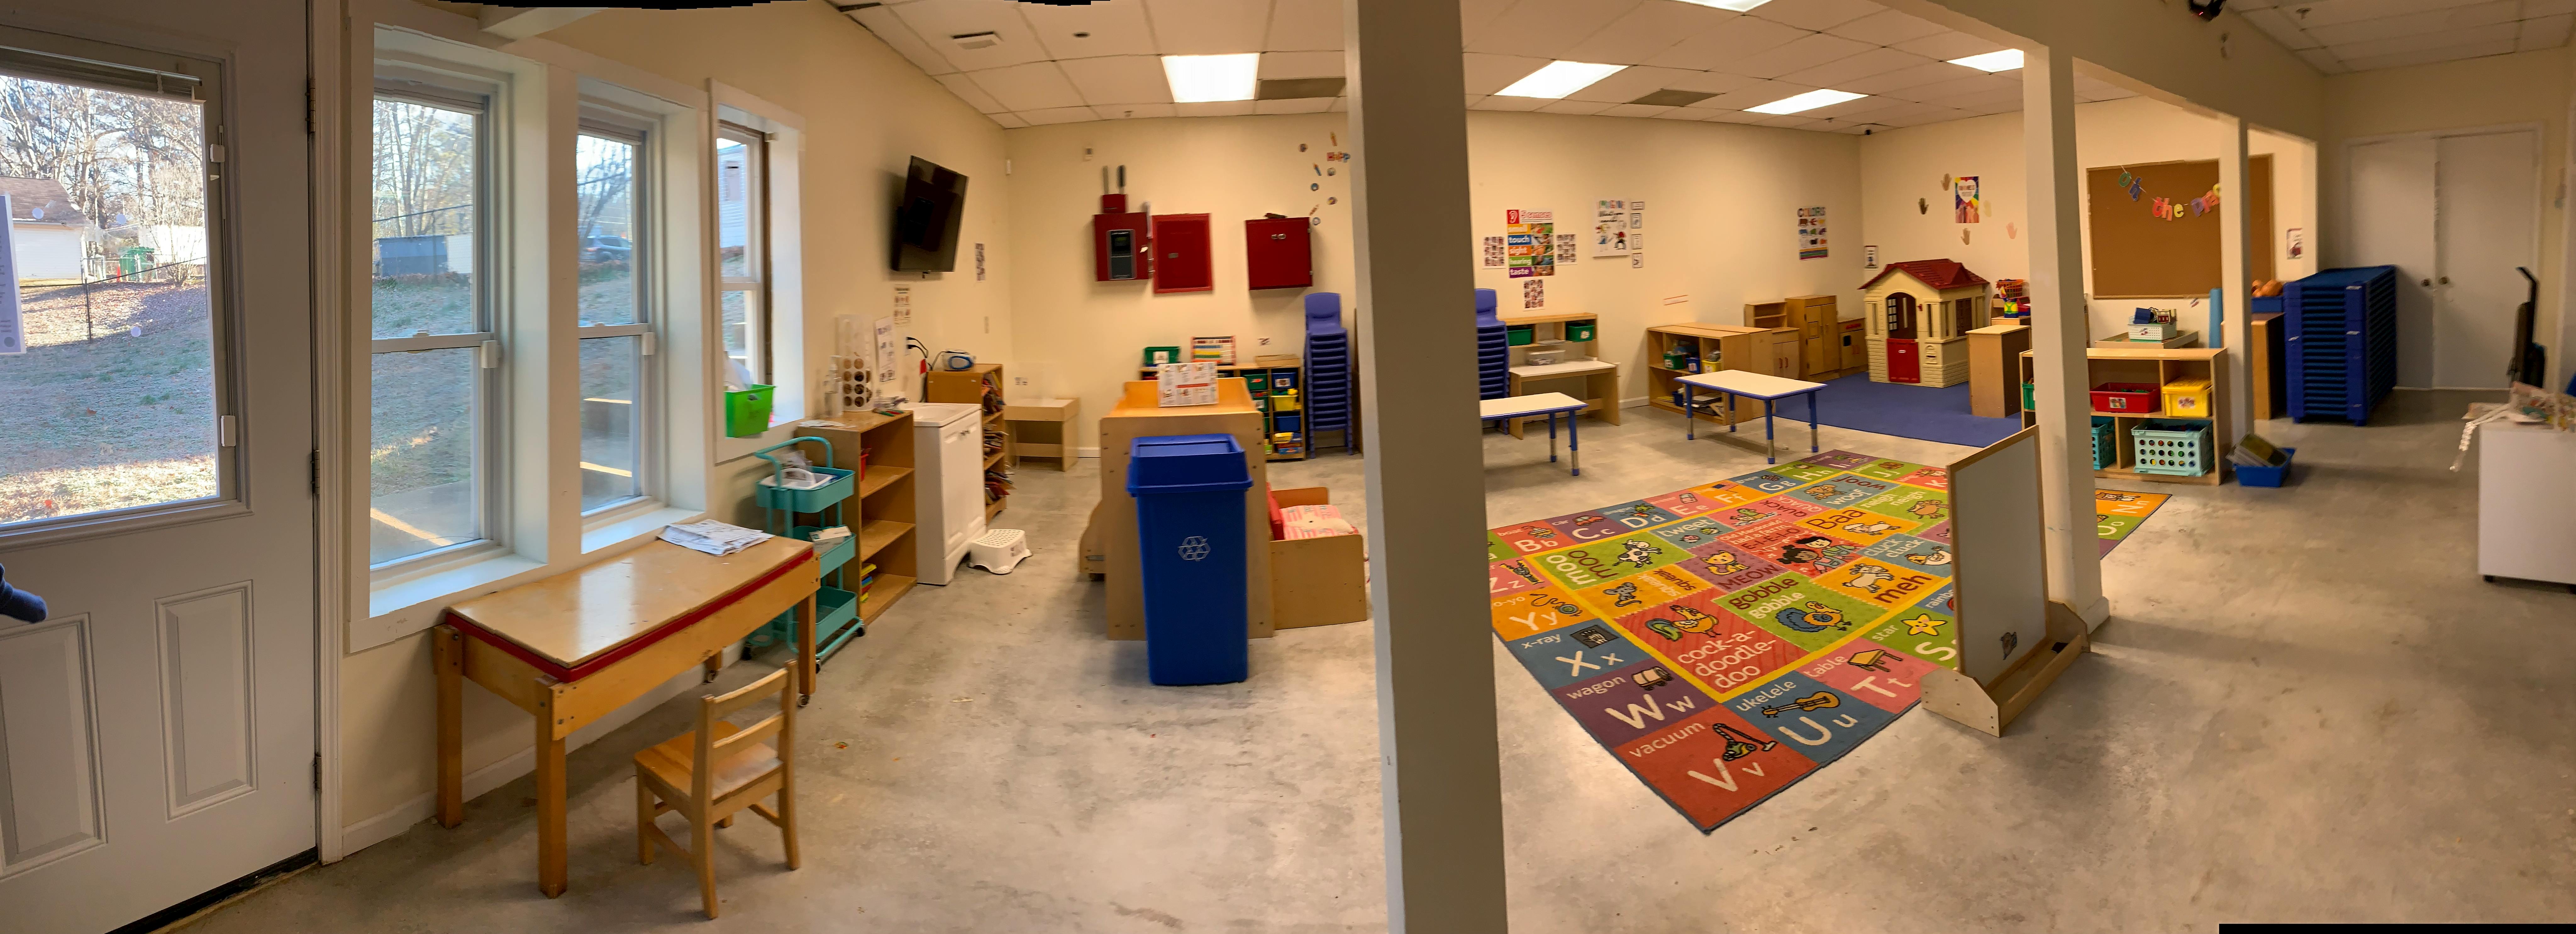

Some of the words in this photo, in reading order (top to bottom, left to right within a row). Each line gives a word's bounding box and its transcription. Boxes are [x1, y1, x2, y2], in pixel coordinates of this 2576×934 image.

[2118, 171, 2142, 201] oh
[2152, 196, 2184, 221] the
[1509, 235, 1530, 243] touch
[1509, 246, 1528, 256] sight
[1832, 475, 1886, 490] woof
[1924, 478, 1947, 487] K
[1774, 496, 1822, 512] QUACK
[1826, 488, 1873, 506] woof
[1860, 493, 1899, 508] neigh
[1890, 490, 1926, 506] neigh
[1760, 500, 1807, 517] QUACK
[1656, 518, 1716, 538] tweet
[1806, 509, 1867, 530] Baa
[1729, 536, 1756, 544] had
[1741, 528, 1800, 550] E-I-E-I-O
[1863, 537, 1904, 557] cluck
[1885, 539, 1926, 558] cluck
[1545, 555, 1597, 585] moo
[1568, 550, 1619, 579] moo
[1637, 574, 1681, 596] squeak
[1653, 568, 1696, 591] squeak
[1717, 564, 1781, 590] MEOW
[1729, 578, 1799, 610] gobble
[1874, 574, 1932, 604] meh
[1925, 589, 1954, 609] rainbo
[1491, 596, 1525, 608] o-yo
[1748, 592, 1806, 619] gobble
[1521, 633, 1562, 649] x-ray
[1872, 624, 1899, 641] star
[1678, 630, 1756, 664] cock-a-
[1695, 639, 1777, 677] doodle-
[1803, 655, 1849, 677] table
[1566, 676, 1627, 699] wagon
[1714, 666, 1761, 688] doo
[1735, 680, 1797, 712] ukelele
[1629, 722, 1707, 758] vacuum
